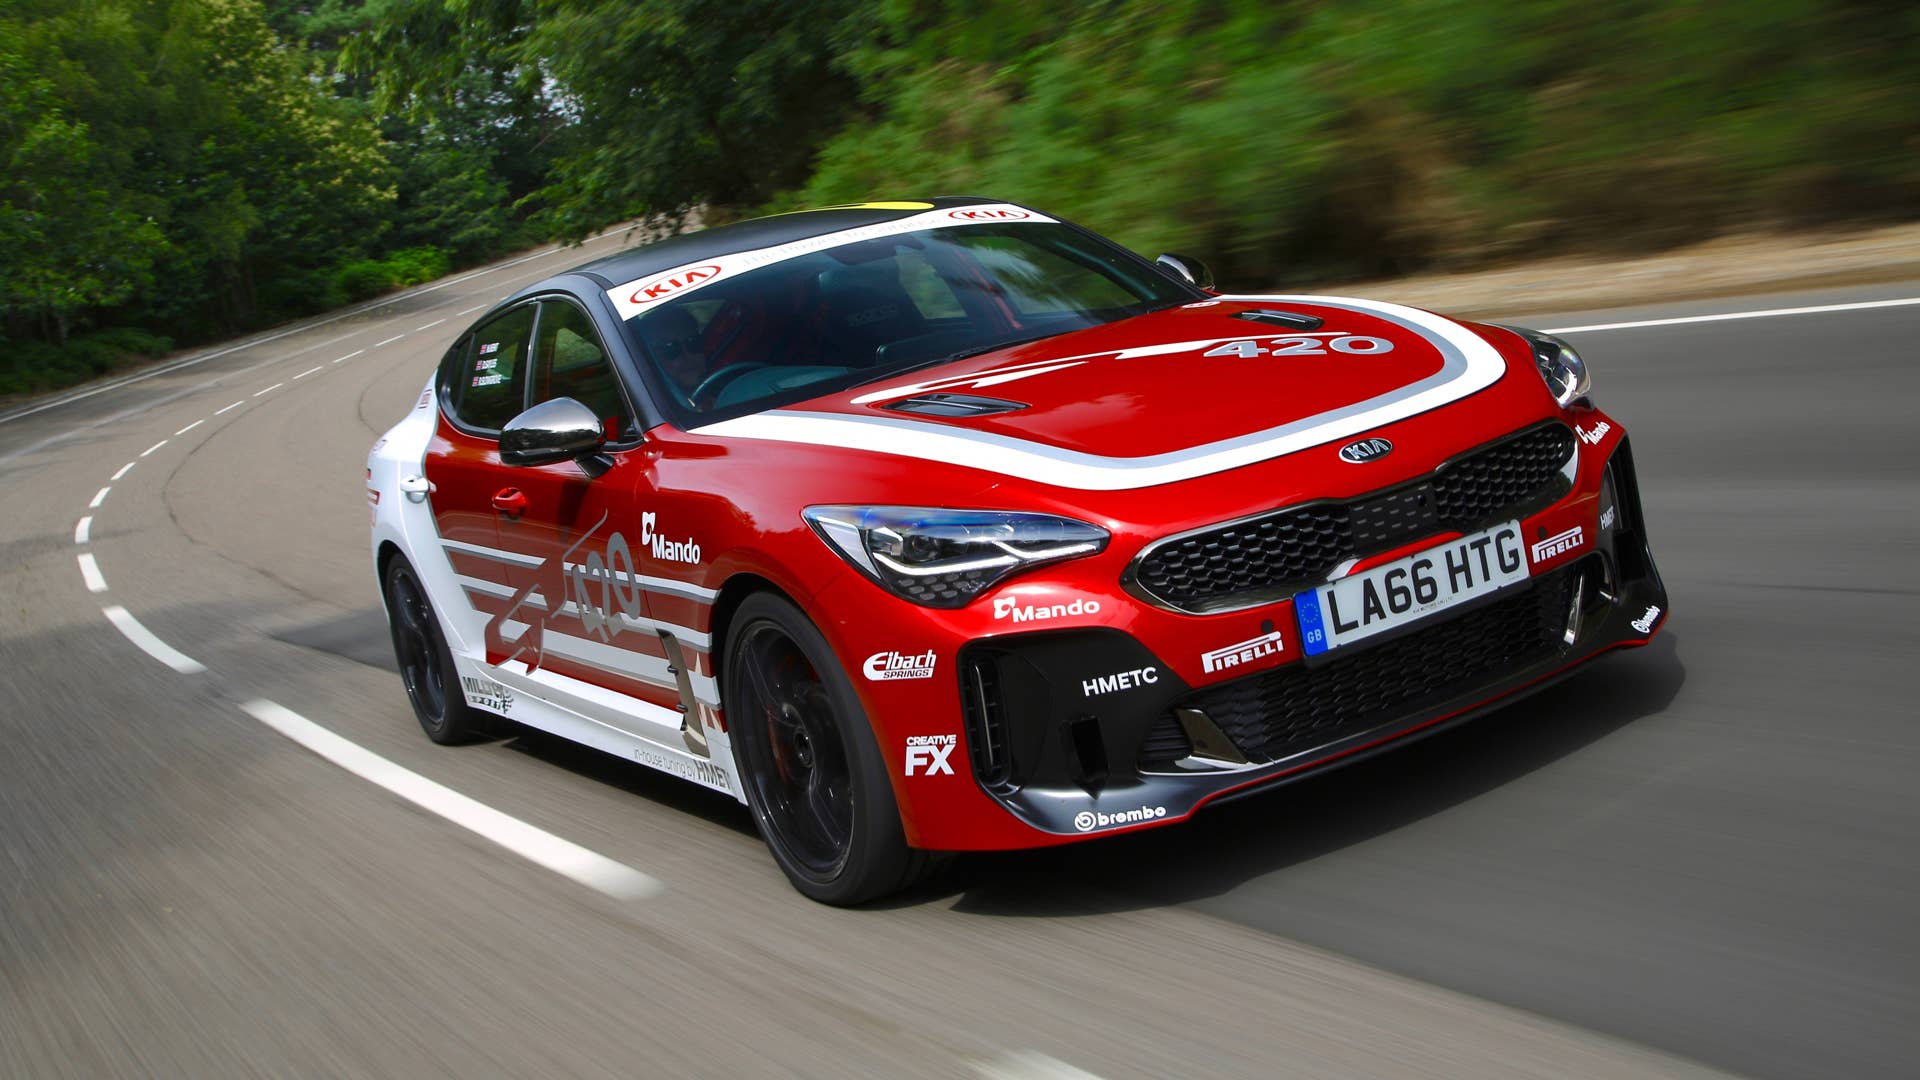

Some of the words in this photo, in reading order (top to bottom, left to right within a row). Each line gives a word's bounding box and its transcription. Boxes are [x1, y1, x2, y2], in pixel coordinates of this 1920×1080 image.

[1203, 336, 1395, 359] 420
[1346, 439, 1390, 460] KIA
[651, 533, 701, 565] Mando
[1531, 525, 1584, 564] PIRELLI
[1327, 558, 1438, 635] LA66
[1445, 528, 1521, 594] HTG
[1012, 598, 1101, 623] Mando
[1306, 628, 1323, 644] GB
[863, 649, 937, 681] Eibach
[1201, 631, 1284, 674] PIRELLI
[883, 669, 929, 679] SPRINGS
[1082, 666, 1158, 697] HMETC
[906, 734, 957, 746] CREATIVE
[905, 744, 956, 777] FX
[1097, 805, 1167, 827] brembo
